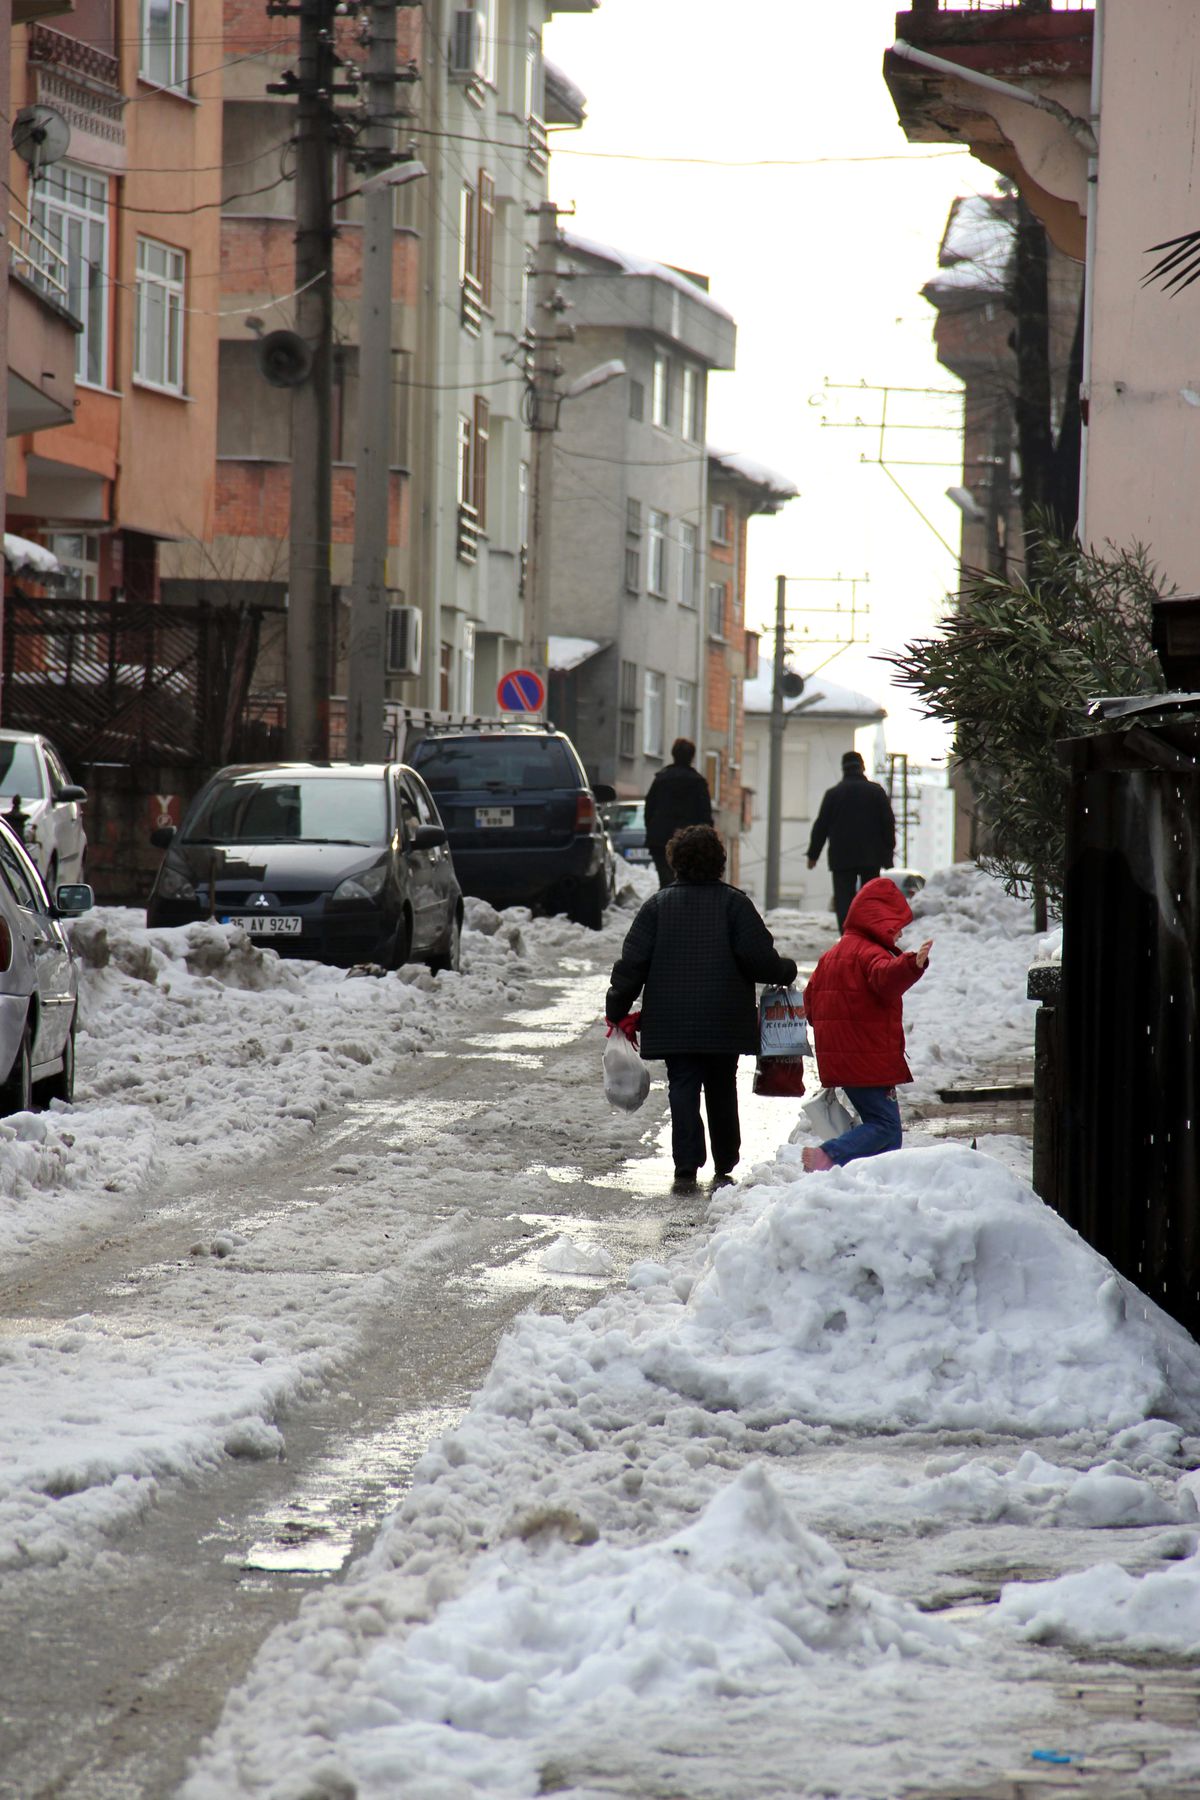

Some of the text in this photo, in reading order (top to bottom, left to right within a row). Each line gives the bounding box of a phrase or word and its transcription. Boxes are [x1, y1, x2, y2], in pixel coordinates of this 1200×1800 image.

[156, 794, 174, 814] Y
[250, 918, 265, 931] AV
[270, 918, 299, 931] 9247
